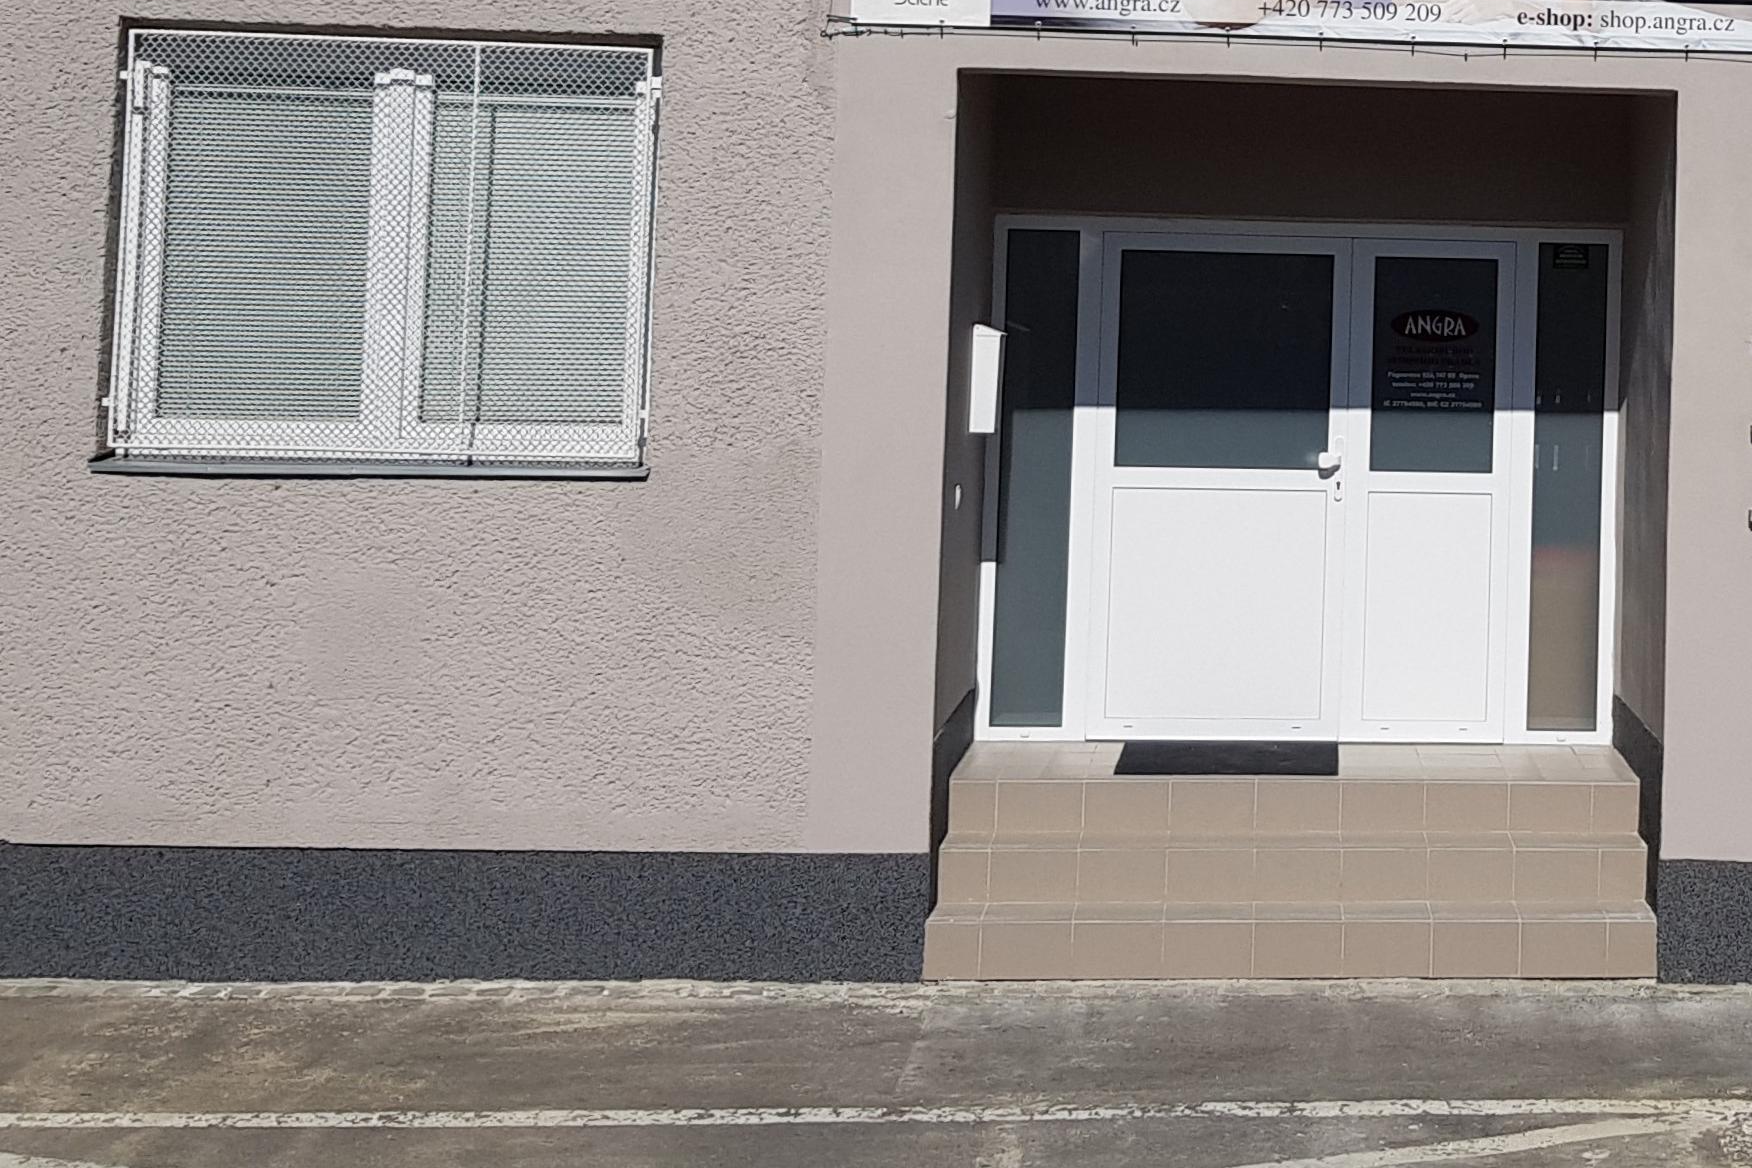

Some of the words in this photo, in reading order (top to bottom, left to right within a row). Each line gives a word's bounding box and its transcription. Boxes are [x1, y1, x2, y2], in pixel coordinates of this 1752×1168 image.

[1316, 0, 1354, 20] 773
[1360, 1, 1398, 21] 509
[1404, 2, 1442, 22] 209
[1516, 7, 1593, 32] e-shop:
[1600, 9, 1736, 36] shop.angra.cz
[1404, 315, 1467, 337] ANGRA
